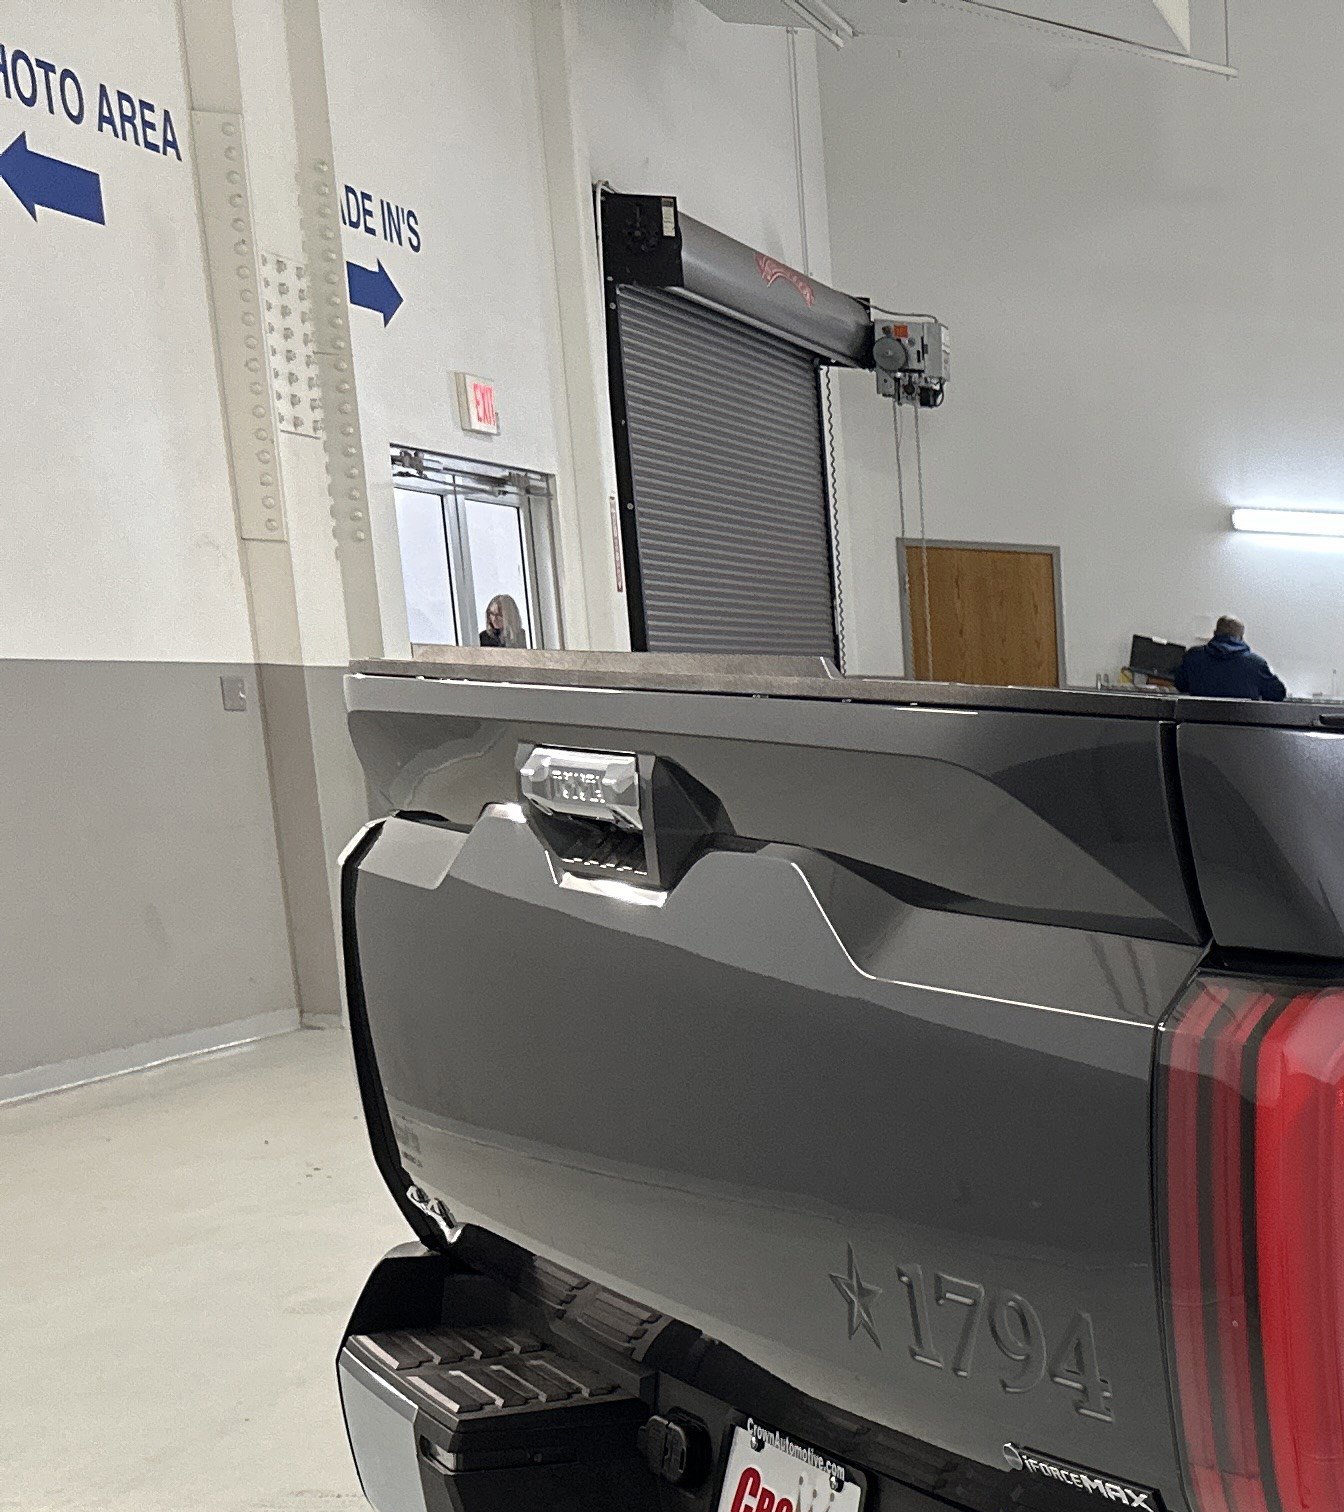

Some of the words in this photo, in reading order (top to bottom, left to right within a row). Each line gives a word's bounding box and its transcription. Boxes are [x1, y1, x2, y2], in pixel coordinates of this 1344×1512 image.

[98, 83, 182, 162] AREA
[380, 198, 421, 253] IN'S
[473, 383, 496, 427] EXIT
[896, 1263, 1116, 1423] 1794
[746, 1416, 846, 1481] CrownAutomotive.com
